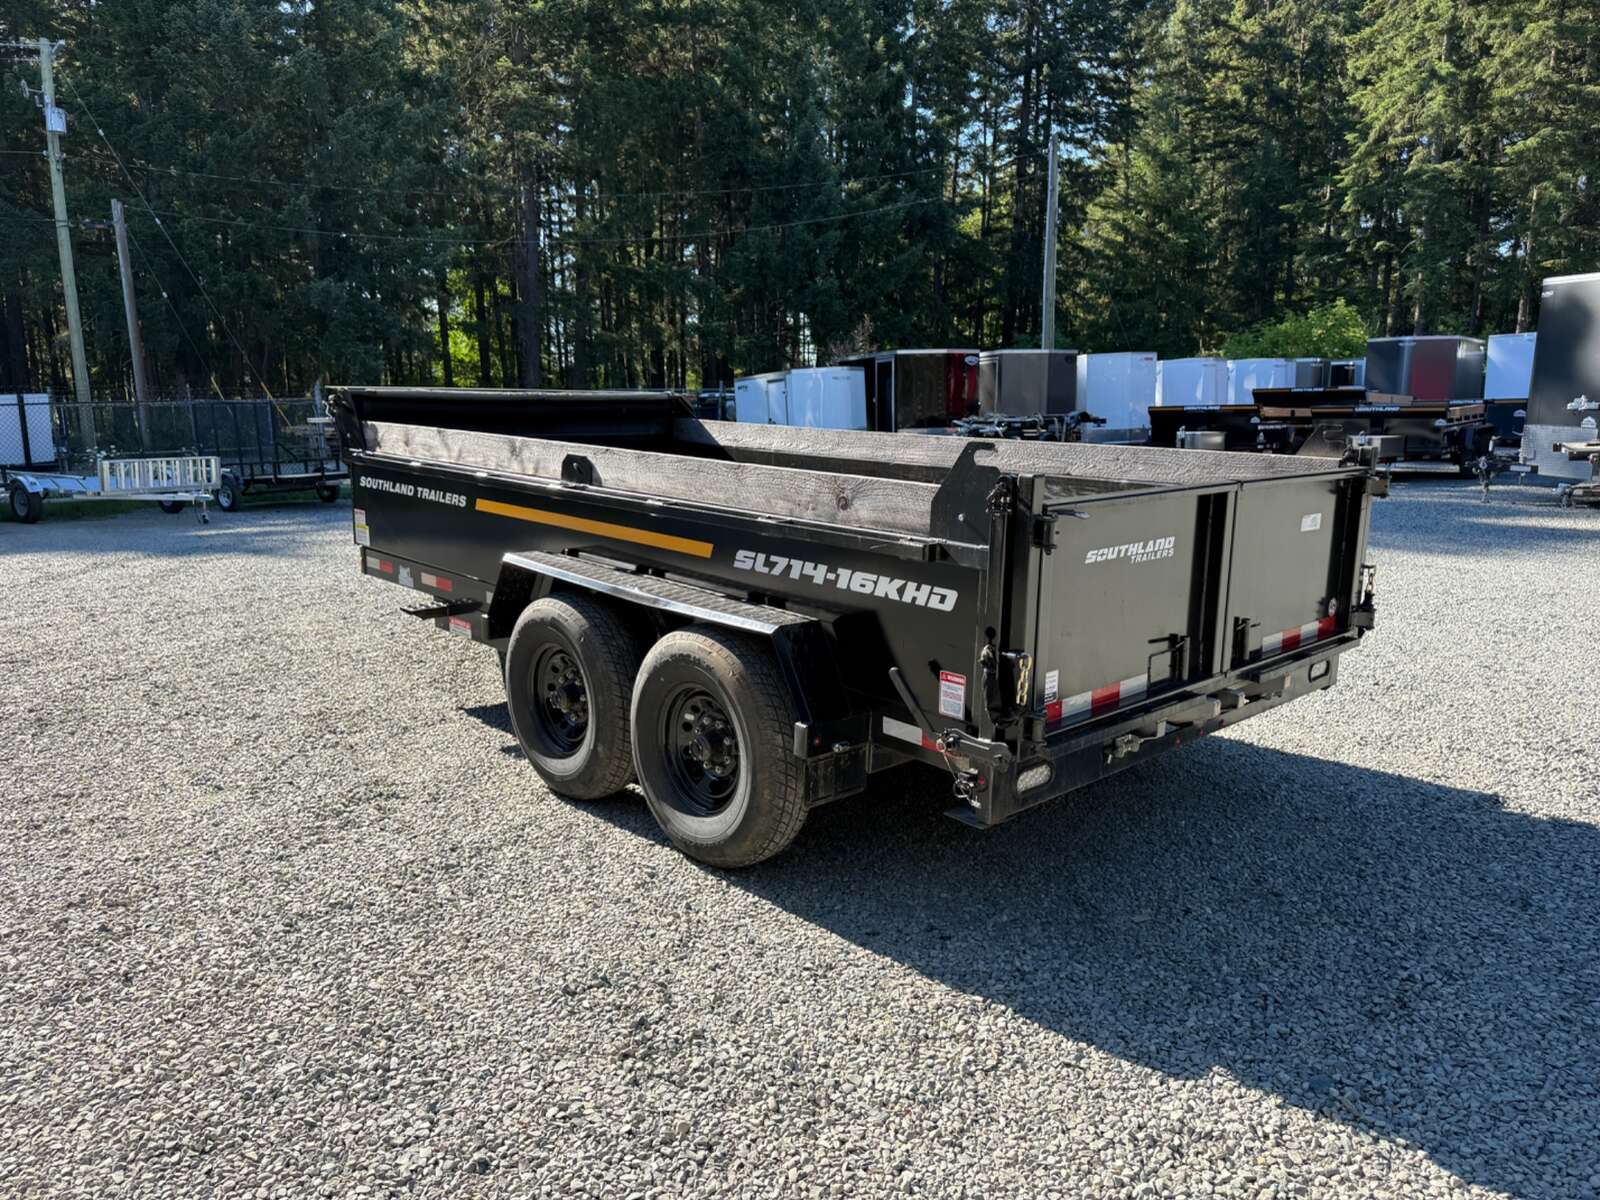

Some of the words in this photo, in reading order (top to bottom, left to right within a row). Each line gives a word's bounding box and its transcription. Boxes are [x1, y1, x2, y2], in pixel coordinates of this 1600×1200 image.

[360, 476, 415, 496] SOUTHLAND
[416, 486, 467, 508] TRAILERS
[1085, 536, 1175, 564] SOUTHLAND
[1131, 548, 1174, 564] TRAILERS
[733, 550, 959, 612] SL714-16KHD
